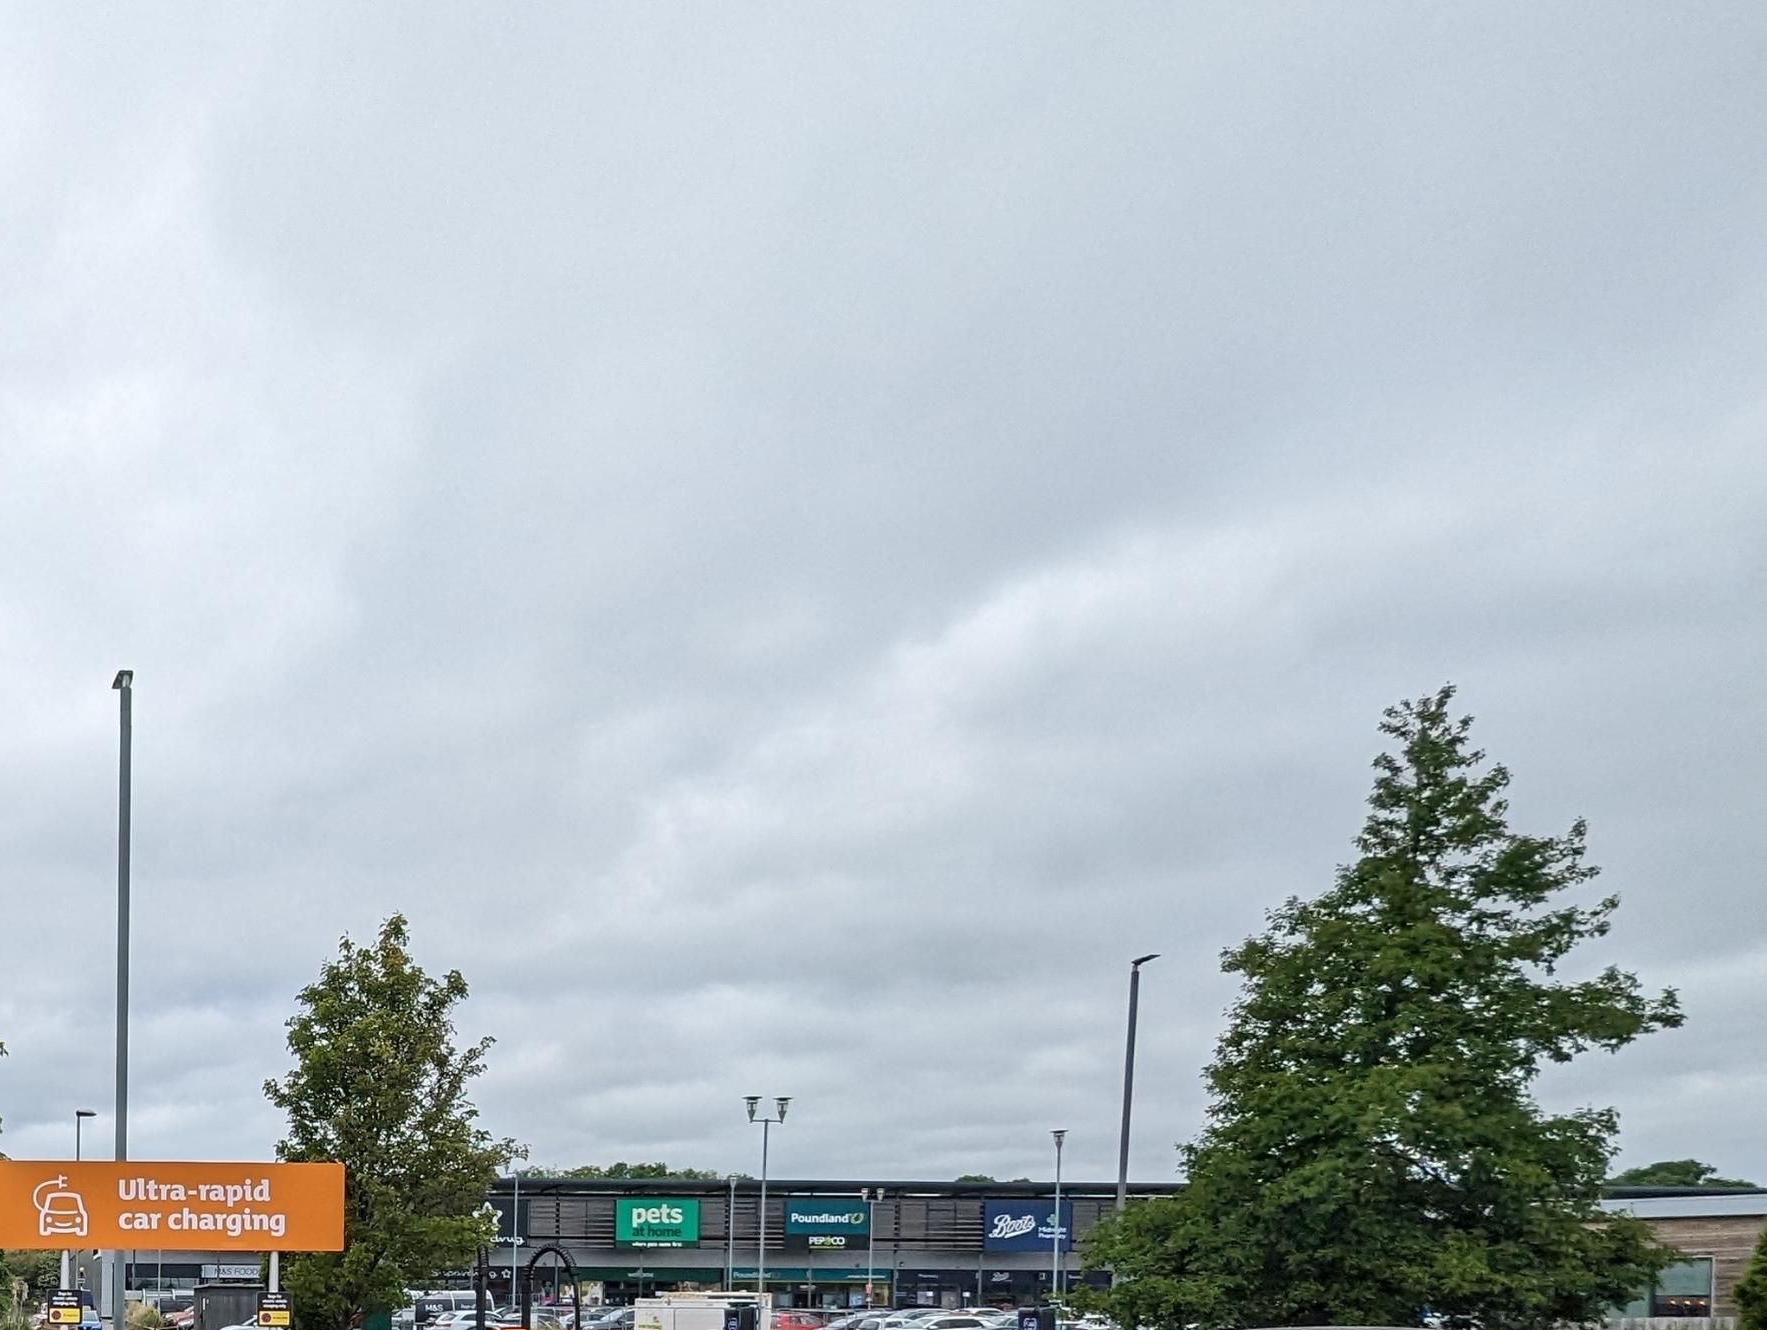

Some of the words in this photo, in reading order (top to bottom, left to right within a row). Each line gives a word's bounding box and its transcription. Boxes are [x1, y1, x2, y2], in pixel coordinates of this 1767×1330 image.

[118, 1178, 271, 1207] Ultra-rapid
[118, 1212, 162, 1230] car
[167, 1207, 286, 1237] charging
[632, 1203, 683, 1228] pets
[791, 1212, 849, 1223] Poundland
[988, 1214, 1036, 1239] Boots
[632, 1226, 645, 1237] at
[647, 1225, 682, 1237] home
